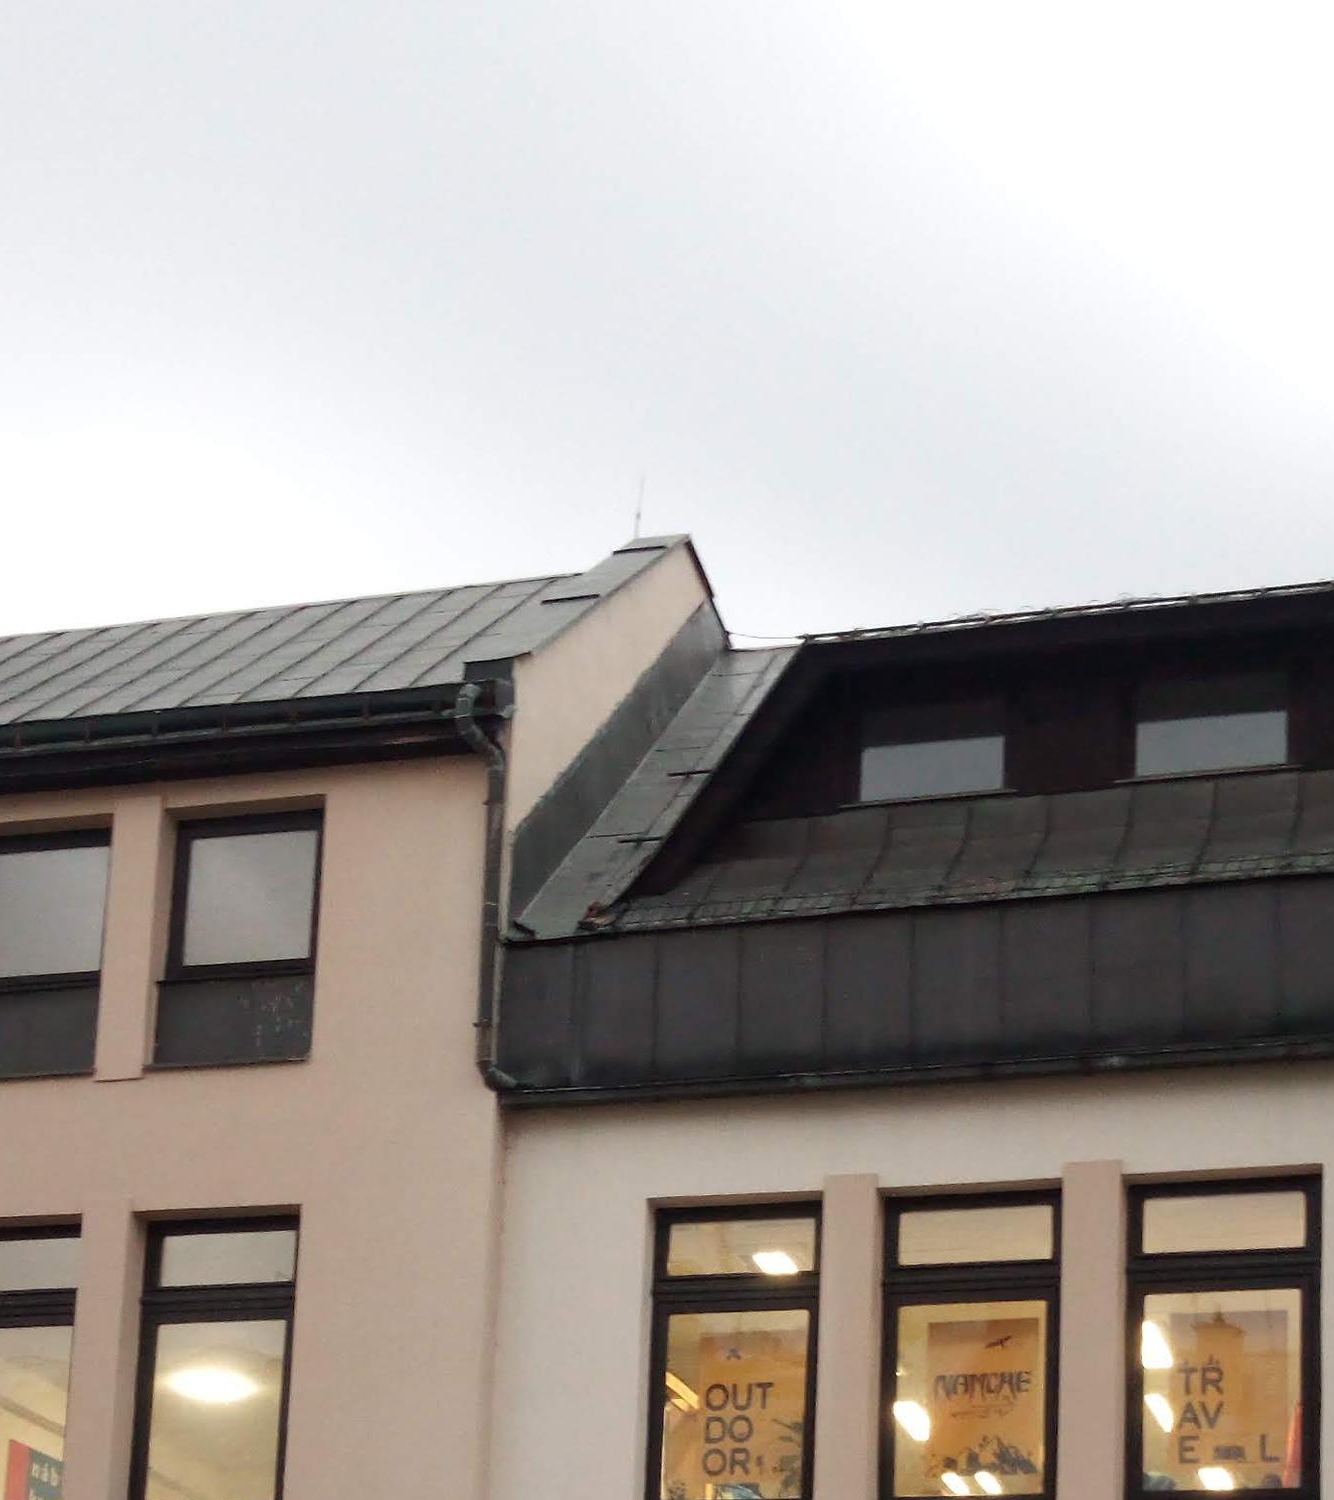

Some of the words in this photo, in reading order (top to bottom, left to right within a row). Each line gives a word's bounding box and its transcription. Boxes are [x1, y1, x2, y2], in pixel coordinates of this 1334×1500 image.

[1178, 1365, 1224, 1396] TR
[705, 1381, 774, 1411] OUT
[704, 1414, 754, 1444] DO
[1177, 1399, 1225, 1430] AV
[702, 1447, 750, 1476] OR
